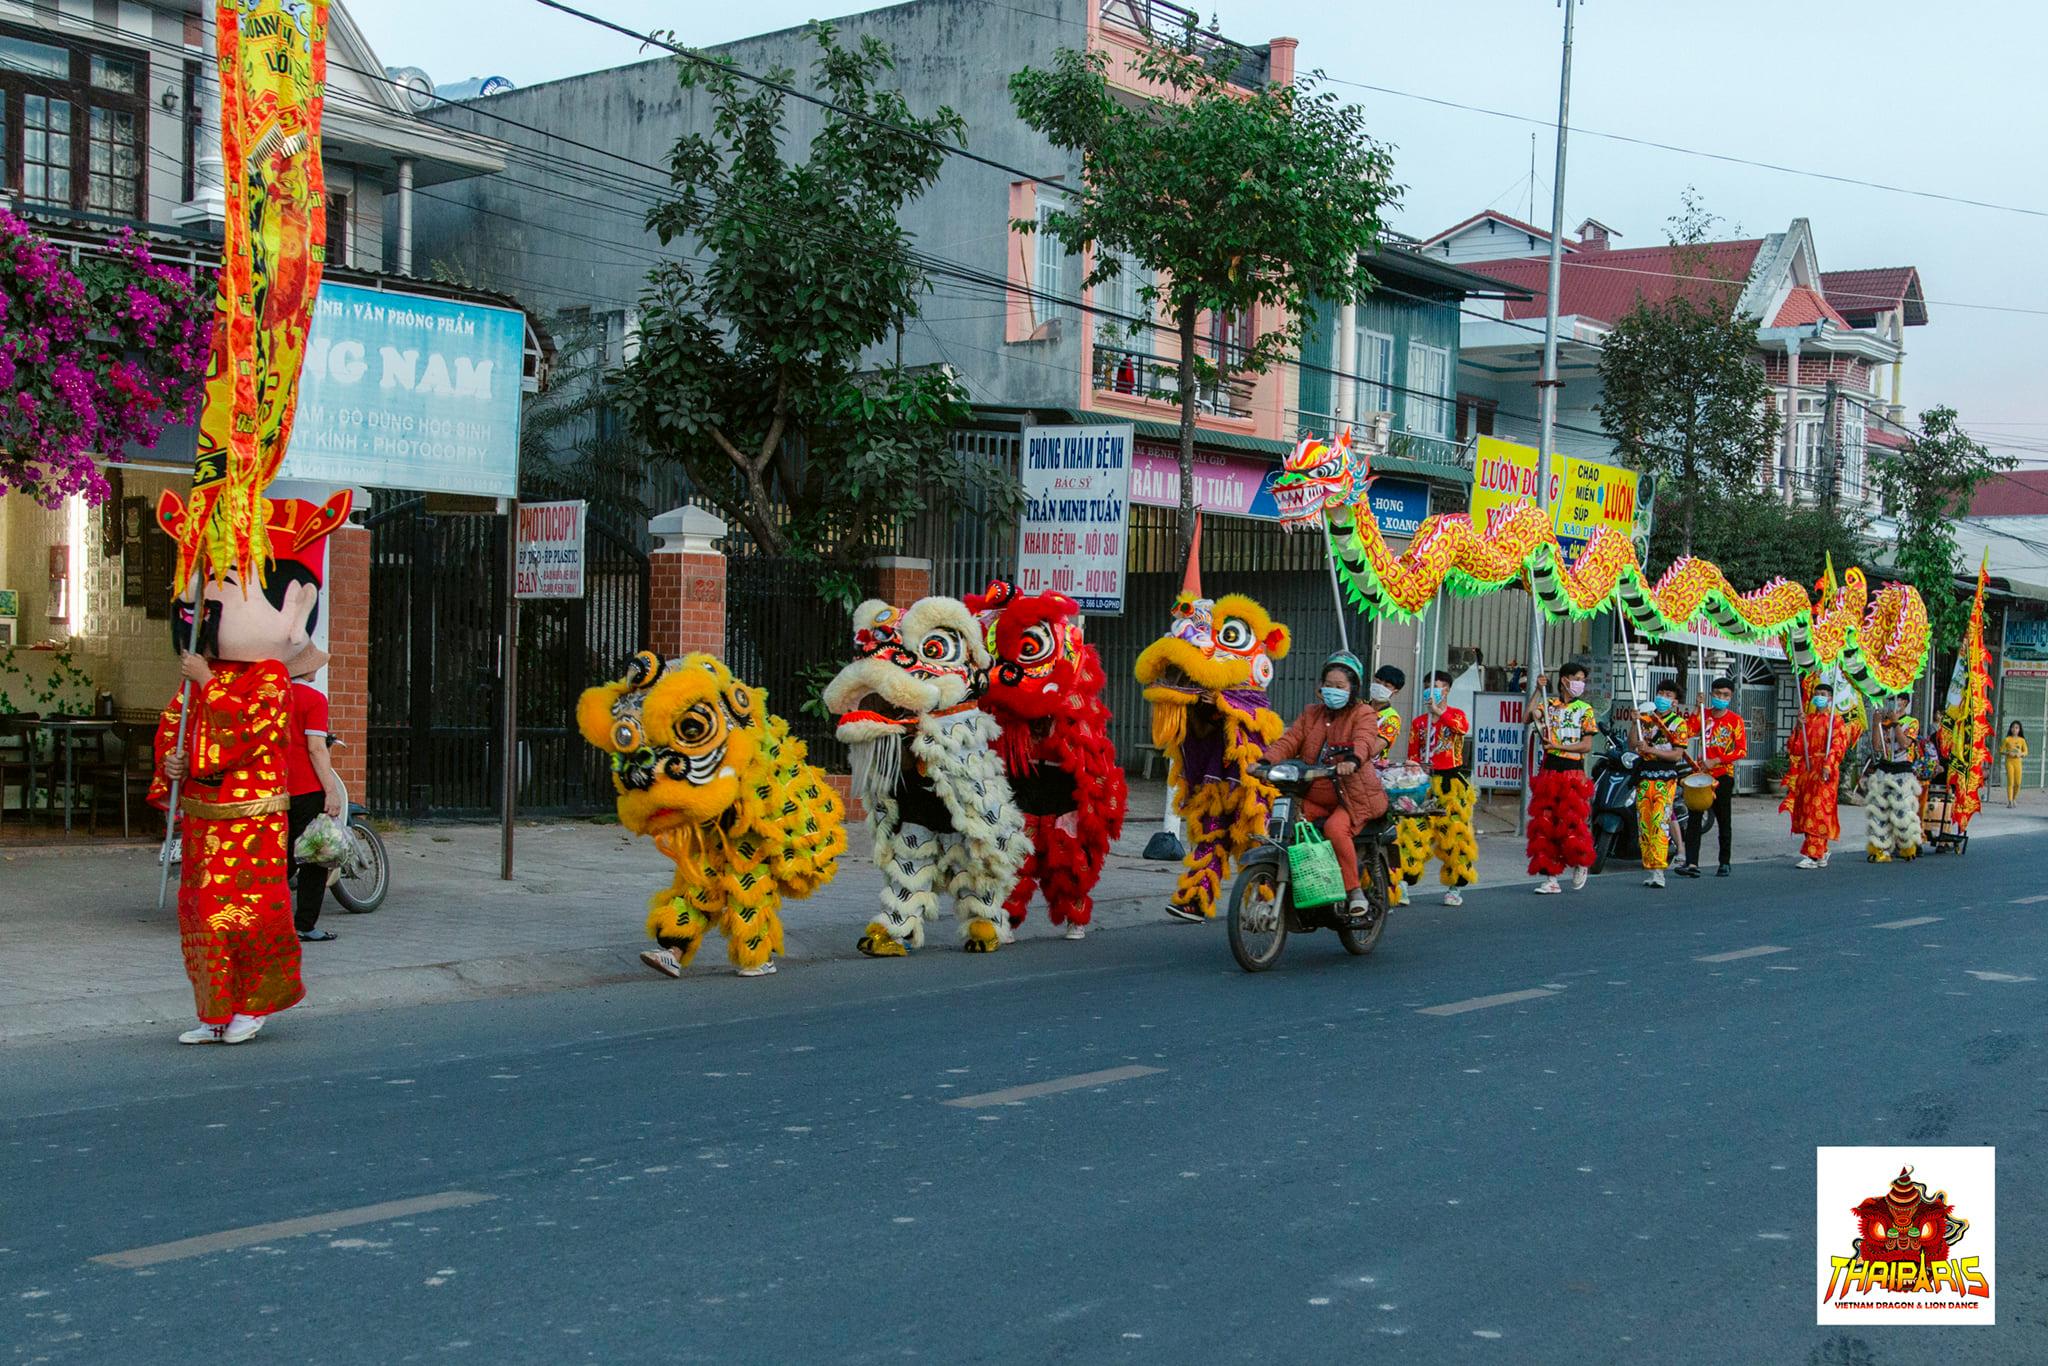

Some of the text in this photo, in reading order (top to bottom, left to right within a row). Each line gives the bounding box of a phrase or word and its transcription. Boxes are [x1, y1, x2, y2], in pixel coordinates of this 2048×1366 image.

[314, 296, 342, 315] ÍNH
[354, 302, 384, 321] VĂN
[388, 309, 434, 329] PHÒNG
[379, 346, 494, 399] NAM
[369, 408, 414, 430] DÙNG
[316, 425, 356, 449] KÍNH
[374, 437, 487, 464] PHOTOCOPPY
[1029, 430, 1123, 476] PHÒNG KHÁM BỆNH
[1054, 476, 1076, 487] BÁC
[1131, 460, 1243, 507] RẦN MH TUẤN
[1480, 456, 1559, 501] LƯƠN ĐG
[1578, 464, 1599, 481] CHÁO
[1026, 488, 1122, 522] TRẦN MINH TUẤN
[1574, 505, 1588, 521] SÚP
[1604, 477, 1634, 523] LƯƠN
[520, 506, 577, 541] PHOTOCOPY
[554, 549, 577, 563] PLASTIC
[1024, 527, 1050, 554] KHÁM
[1052, 528, 1076, 560] BỆNH
[1085, 529, 1100, 560] NỘI
[1103, 533, 1118, 556] SOI
[517, 566, 537, 593] BÁN
[1023, 568, 1040, 590] TAI
[1052, 564, 1074, 591] MŨI
[1086, 570, 1117, 597] HỌNG
[1478, 727, 1518, 744] CÁC MÓN
